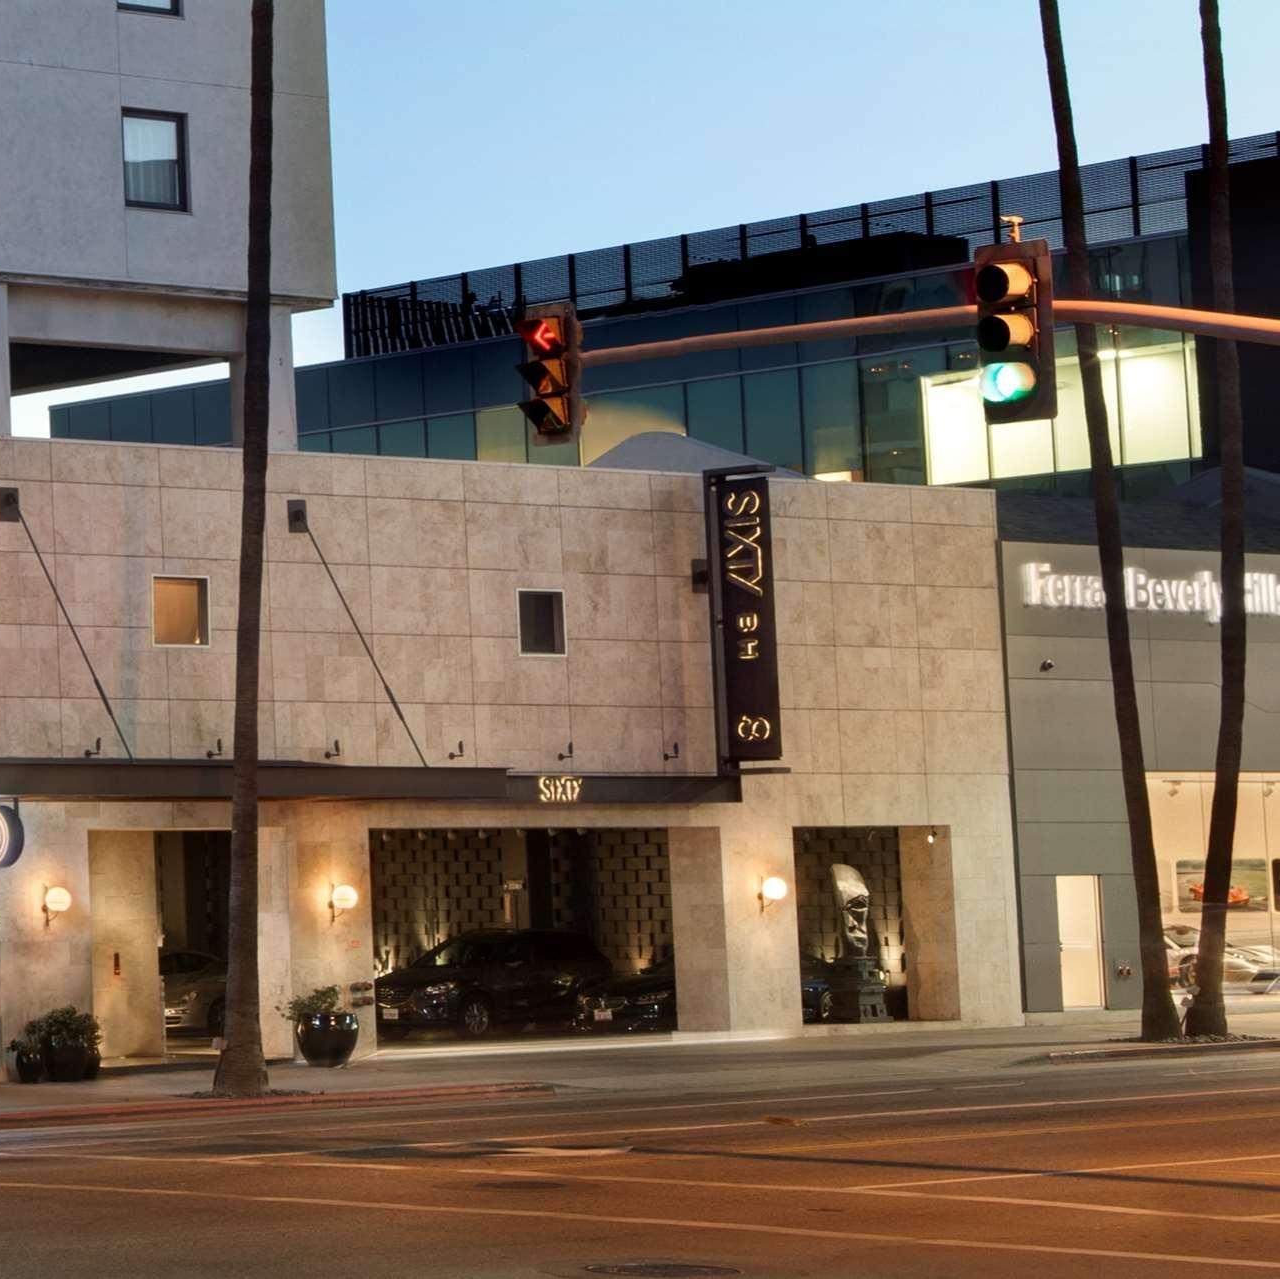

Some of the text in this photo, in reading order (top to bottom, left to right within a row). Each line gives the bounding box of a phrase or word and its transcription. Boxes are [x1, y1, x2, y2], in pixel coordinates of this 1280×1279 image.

[725, 489, 764, 596] SIXTY
[1024, 562, 1107, 608] Ferra
[539, 776, 583, 802] SIXTY
